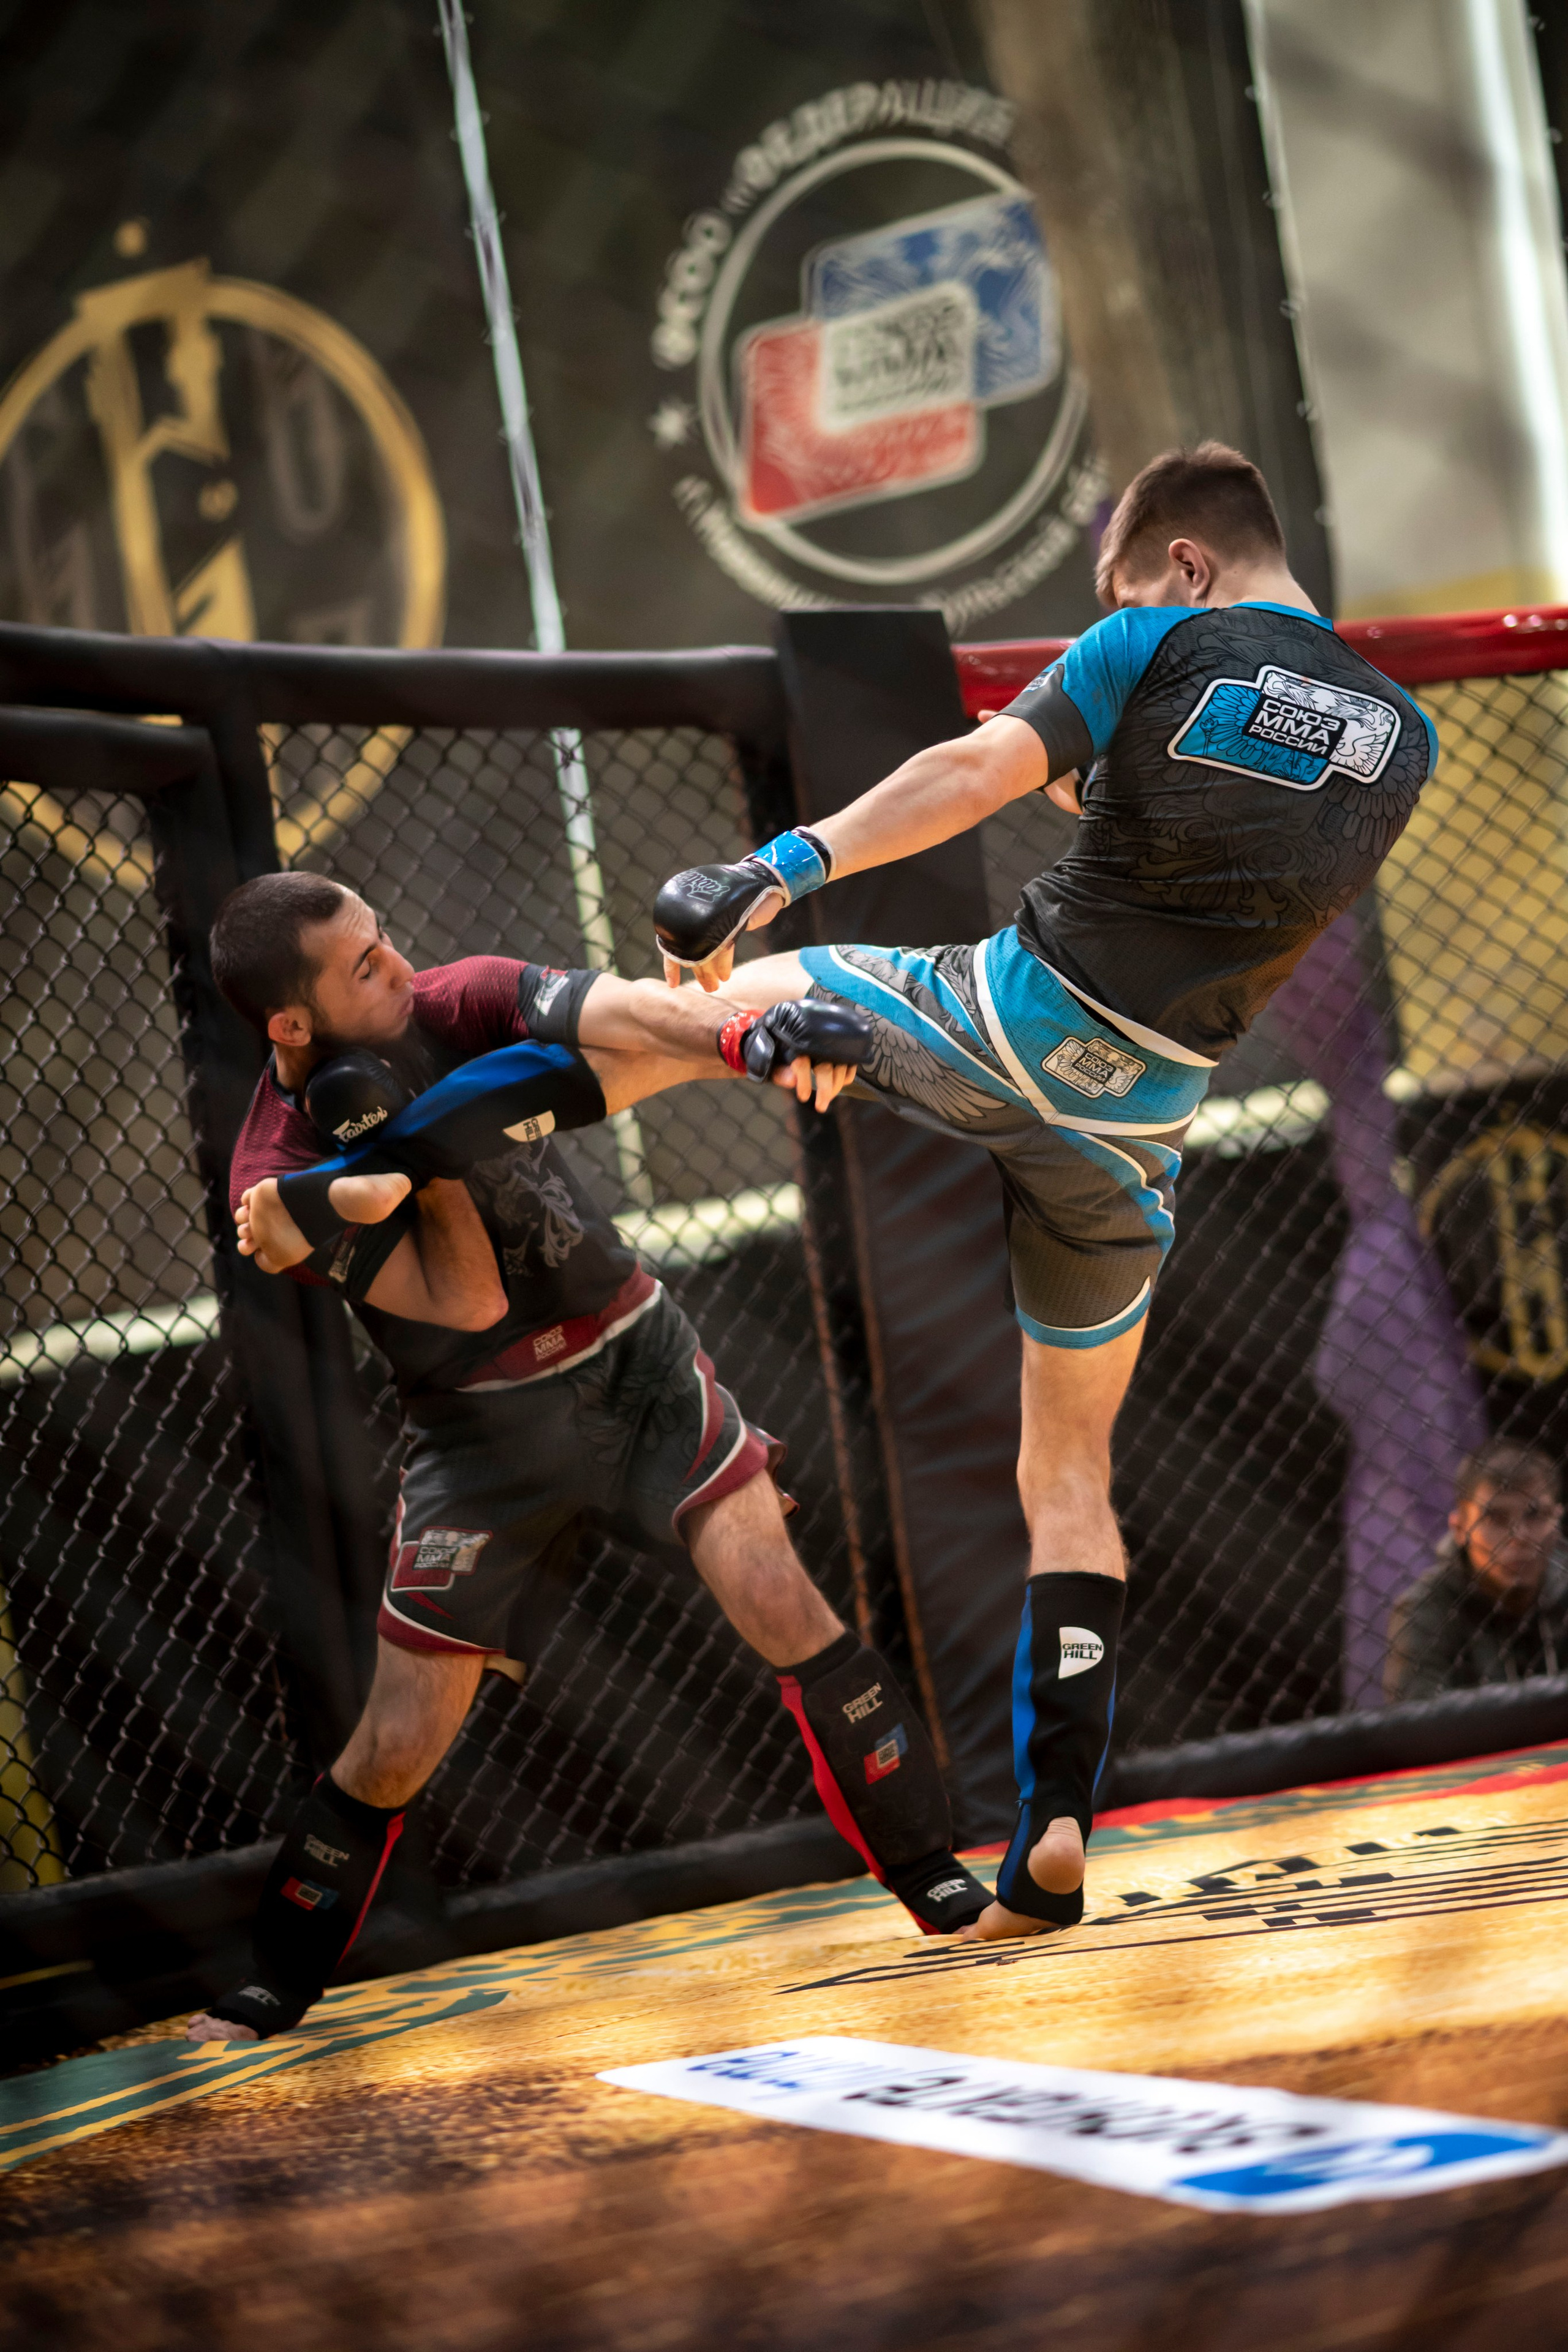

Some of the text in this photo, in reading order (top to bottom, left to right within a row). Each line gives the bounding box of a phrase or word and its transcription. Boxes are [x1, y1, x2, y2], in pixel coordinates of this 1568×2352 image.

[1262, 699, 1341, 731] СОЮЗ
[1254, 710, 1330, 745] ММА
[1248, 725, 1328, 755] РОССИИ
[1074, 1063, 1106, 1082] РОССИИ
[1079, 1057, 1108, 1078] ММА
[1085, 1052, 1114, 1072] СОЮЗ
[332, 1106, 388, 1143] Fairtex
[1062, 1643, 1102, 1651] GREEN
[1064, 1650, 1097, 1660] HILL
[843, 1682, 882, 1713] GREEN
[847, 1697, 883, 1724] HILL
[927, 1879, 966, 1898] GREEN
[933, 1884, 968, 1902] HILL
